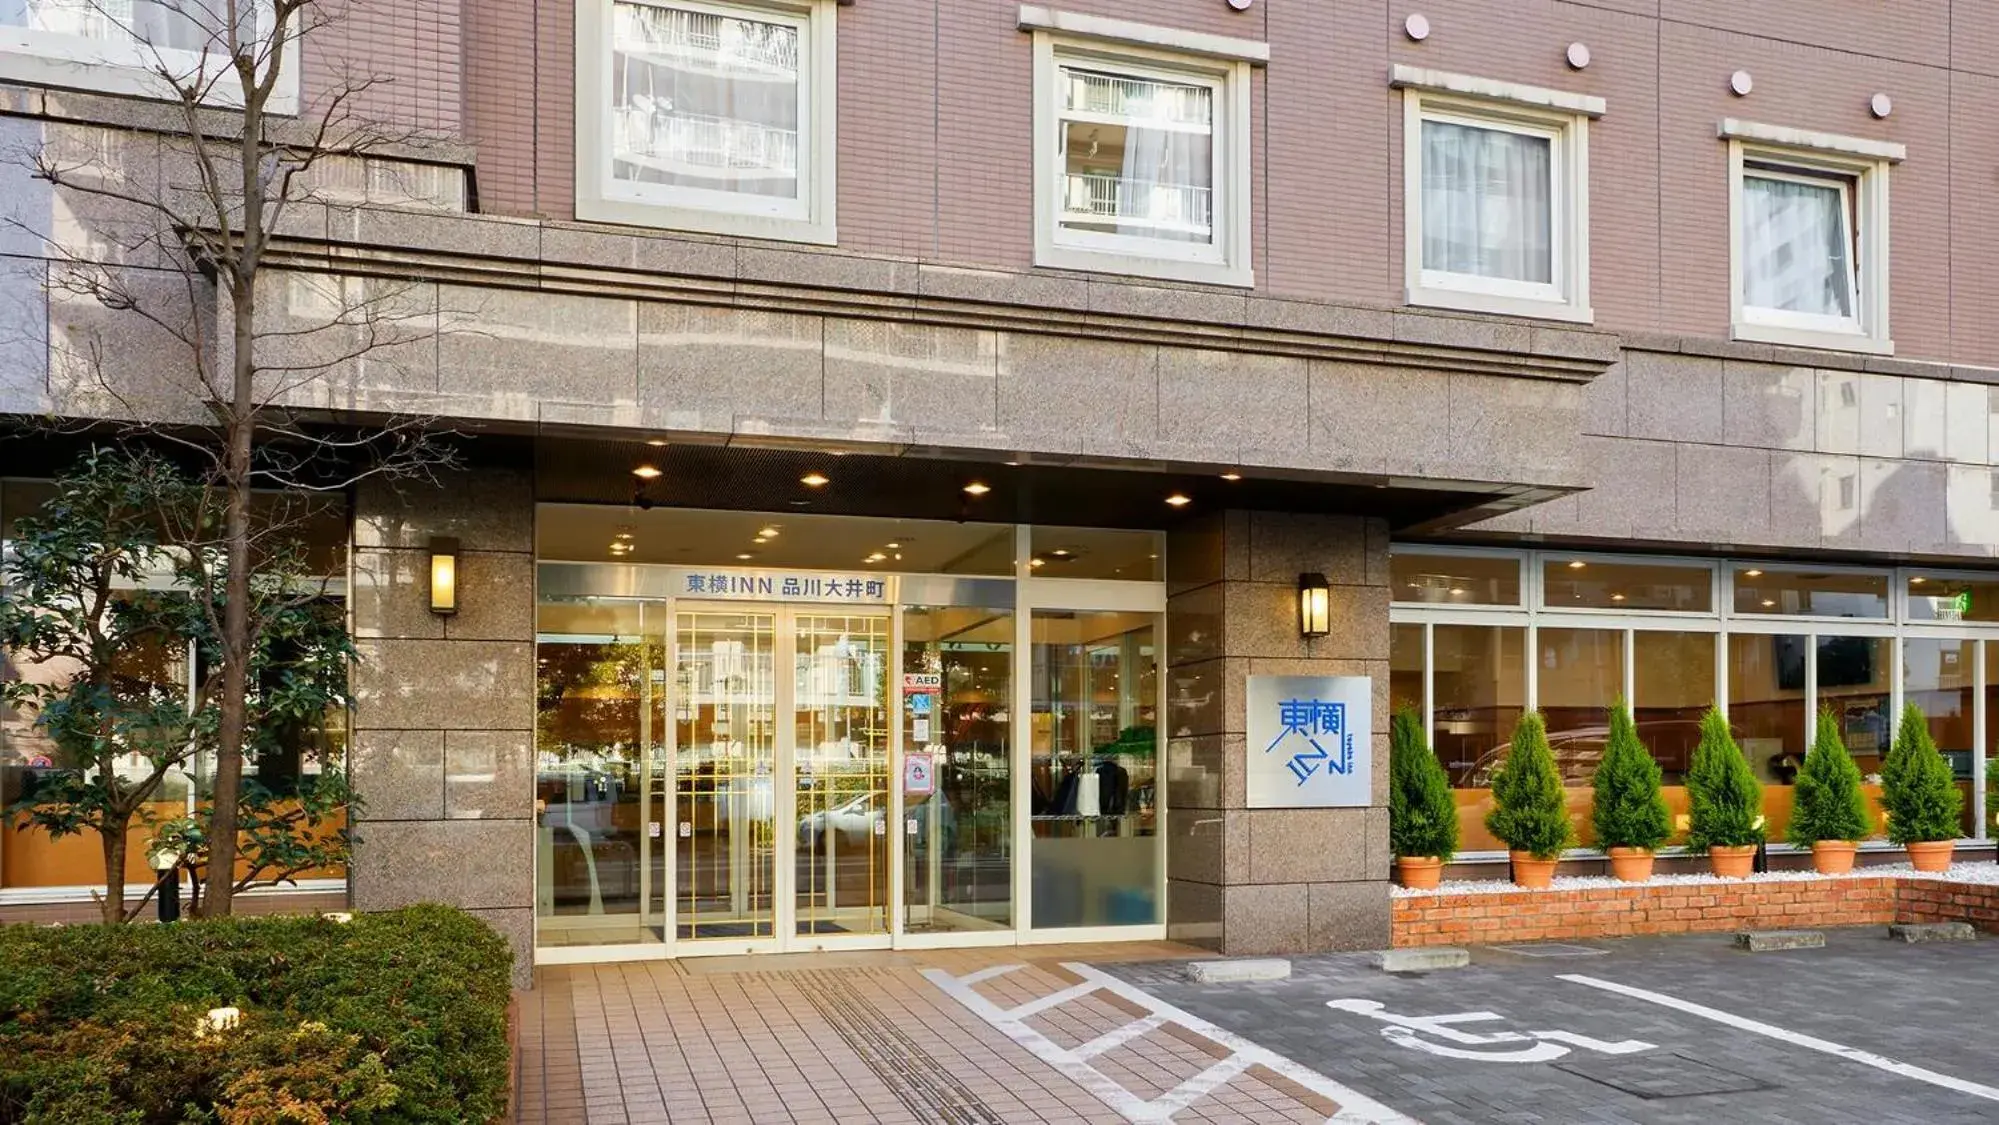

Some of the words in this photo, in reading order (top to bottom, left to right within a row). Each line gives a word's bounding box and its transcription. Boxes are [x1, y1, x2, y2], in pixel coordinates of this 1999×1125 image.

[687, 574, 773, 595] 東横INN
[782, 577, 886, 598] 品川大井町
[916, 676, 939, 685] AED
